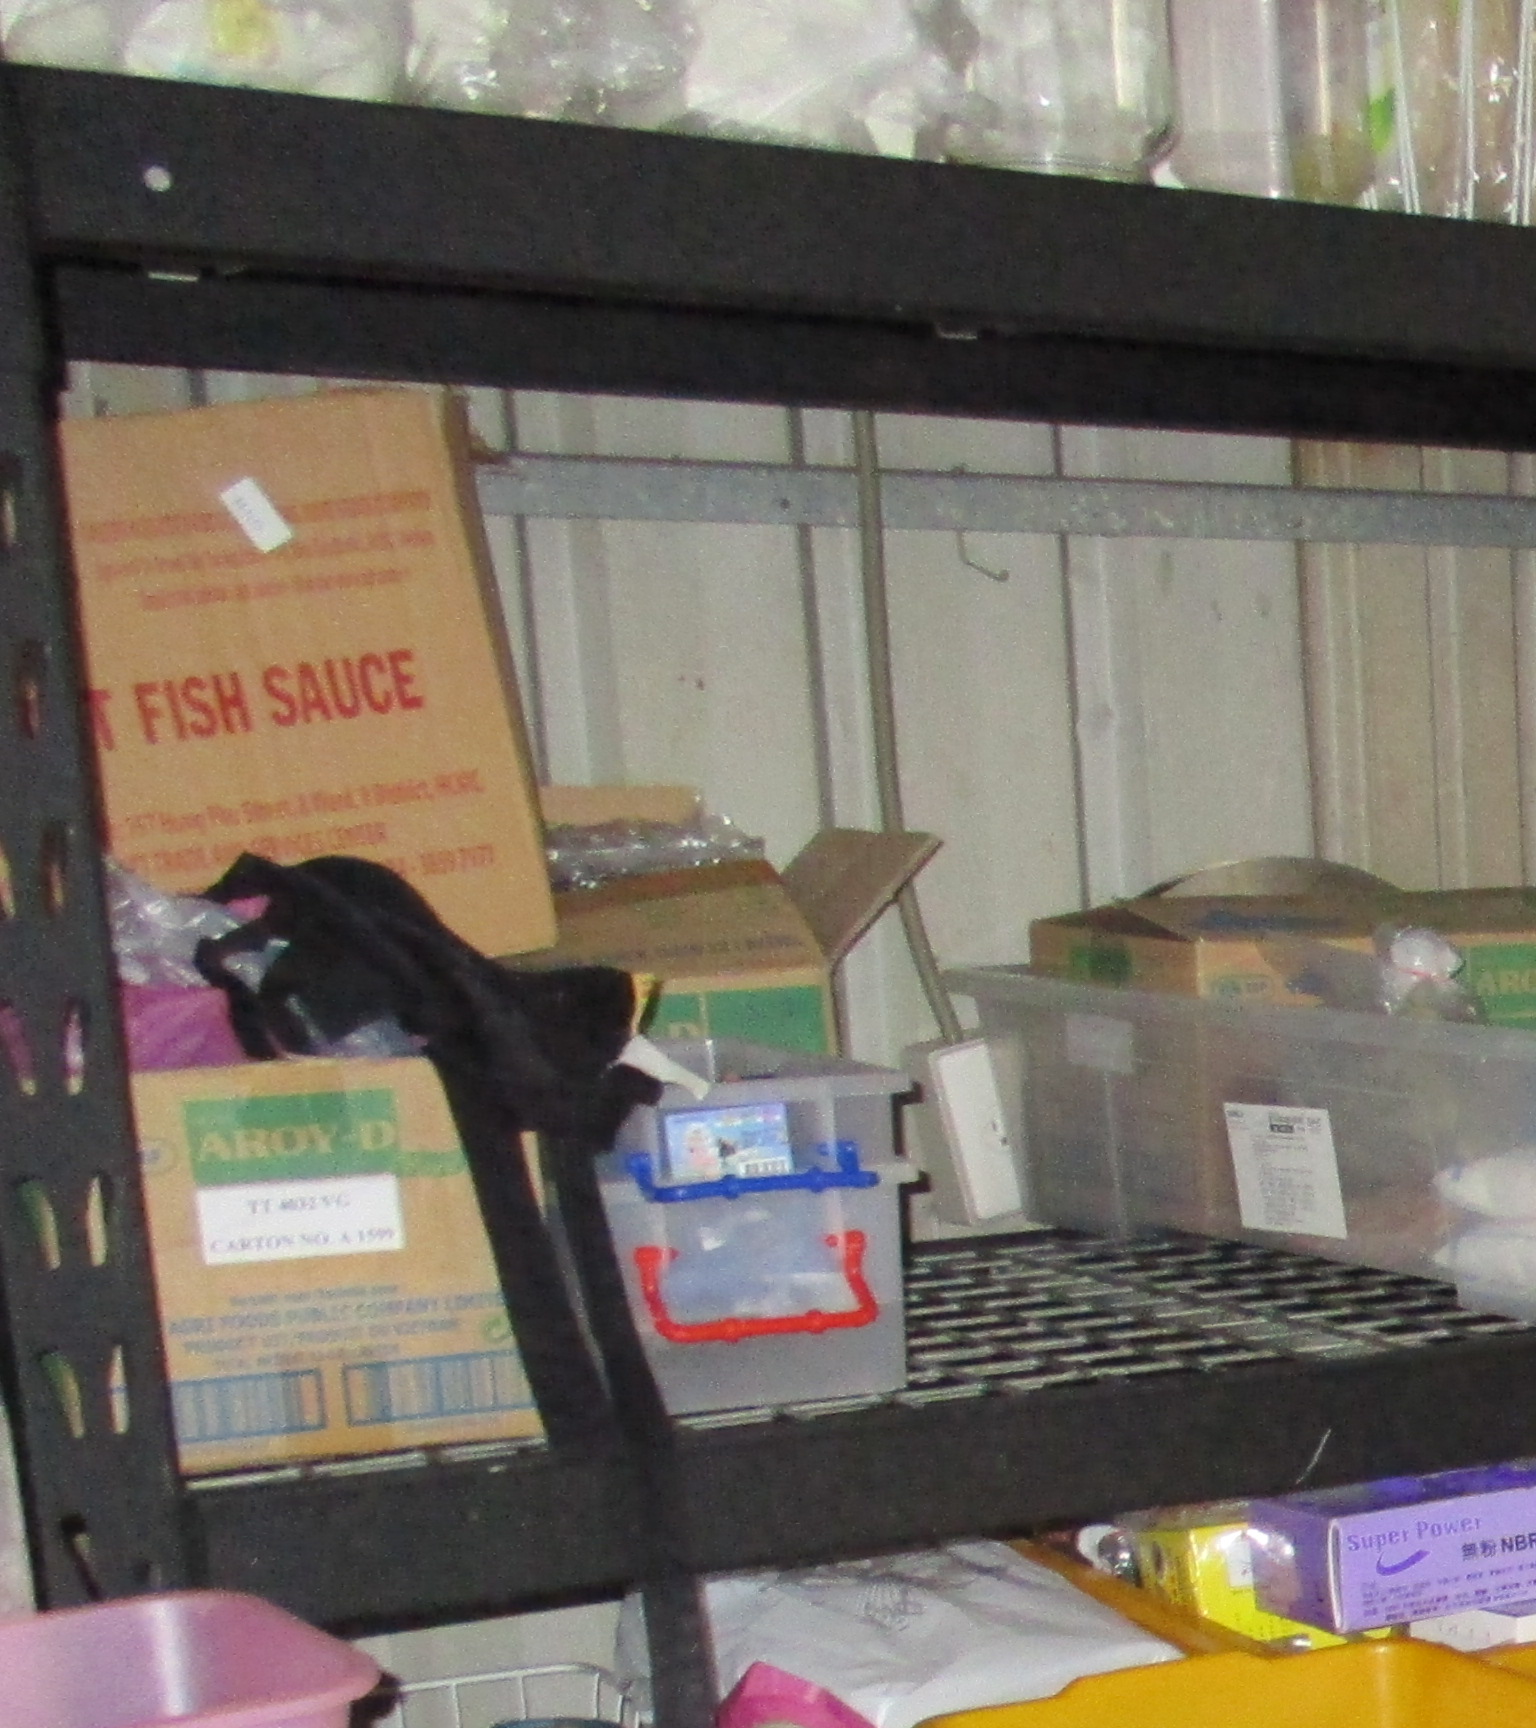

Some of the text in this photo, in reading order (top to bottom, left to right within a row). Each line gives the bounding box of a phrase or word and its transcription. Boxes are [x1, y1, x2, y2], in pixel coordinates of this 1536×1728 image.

[133, 671, 253, 745] FISH
[262, 648, 426, 728] SAUCE
[1347, 1516, 1481, 1551] Super Power
